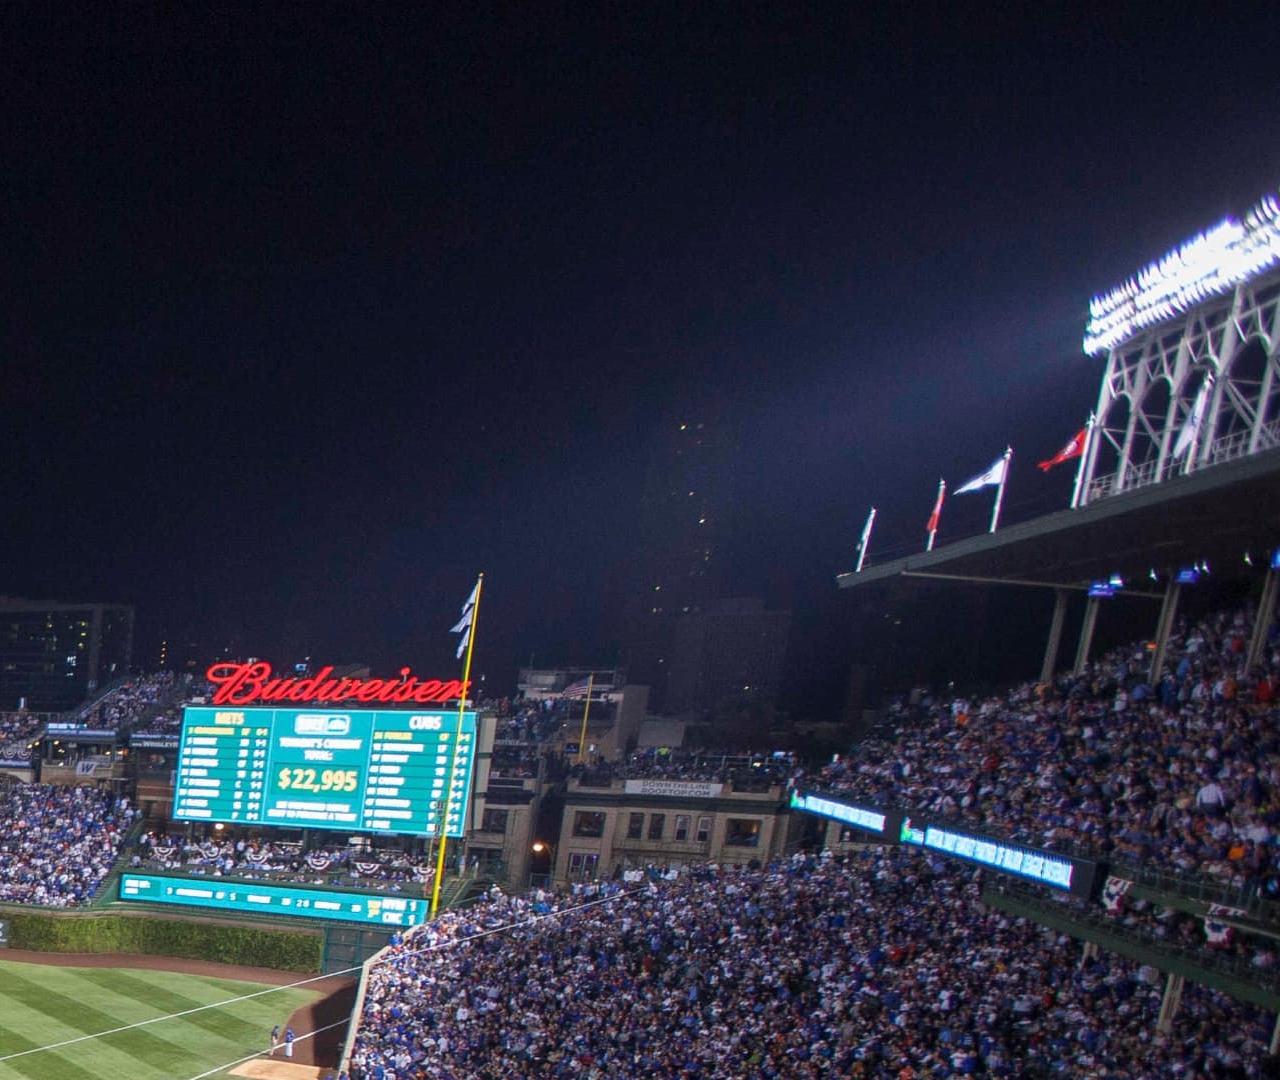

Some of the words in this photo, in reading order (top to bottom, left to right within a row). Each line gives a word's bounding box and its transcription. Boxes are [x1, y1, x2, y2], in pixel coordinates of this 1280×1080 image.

[206, 662, 472, 705] Budweiser
[409, 715, 443, 730] CUBS
[278, 767, 358, 793] $22,995
